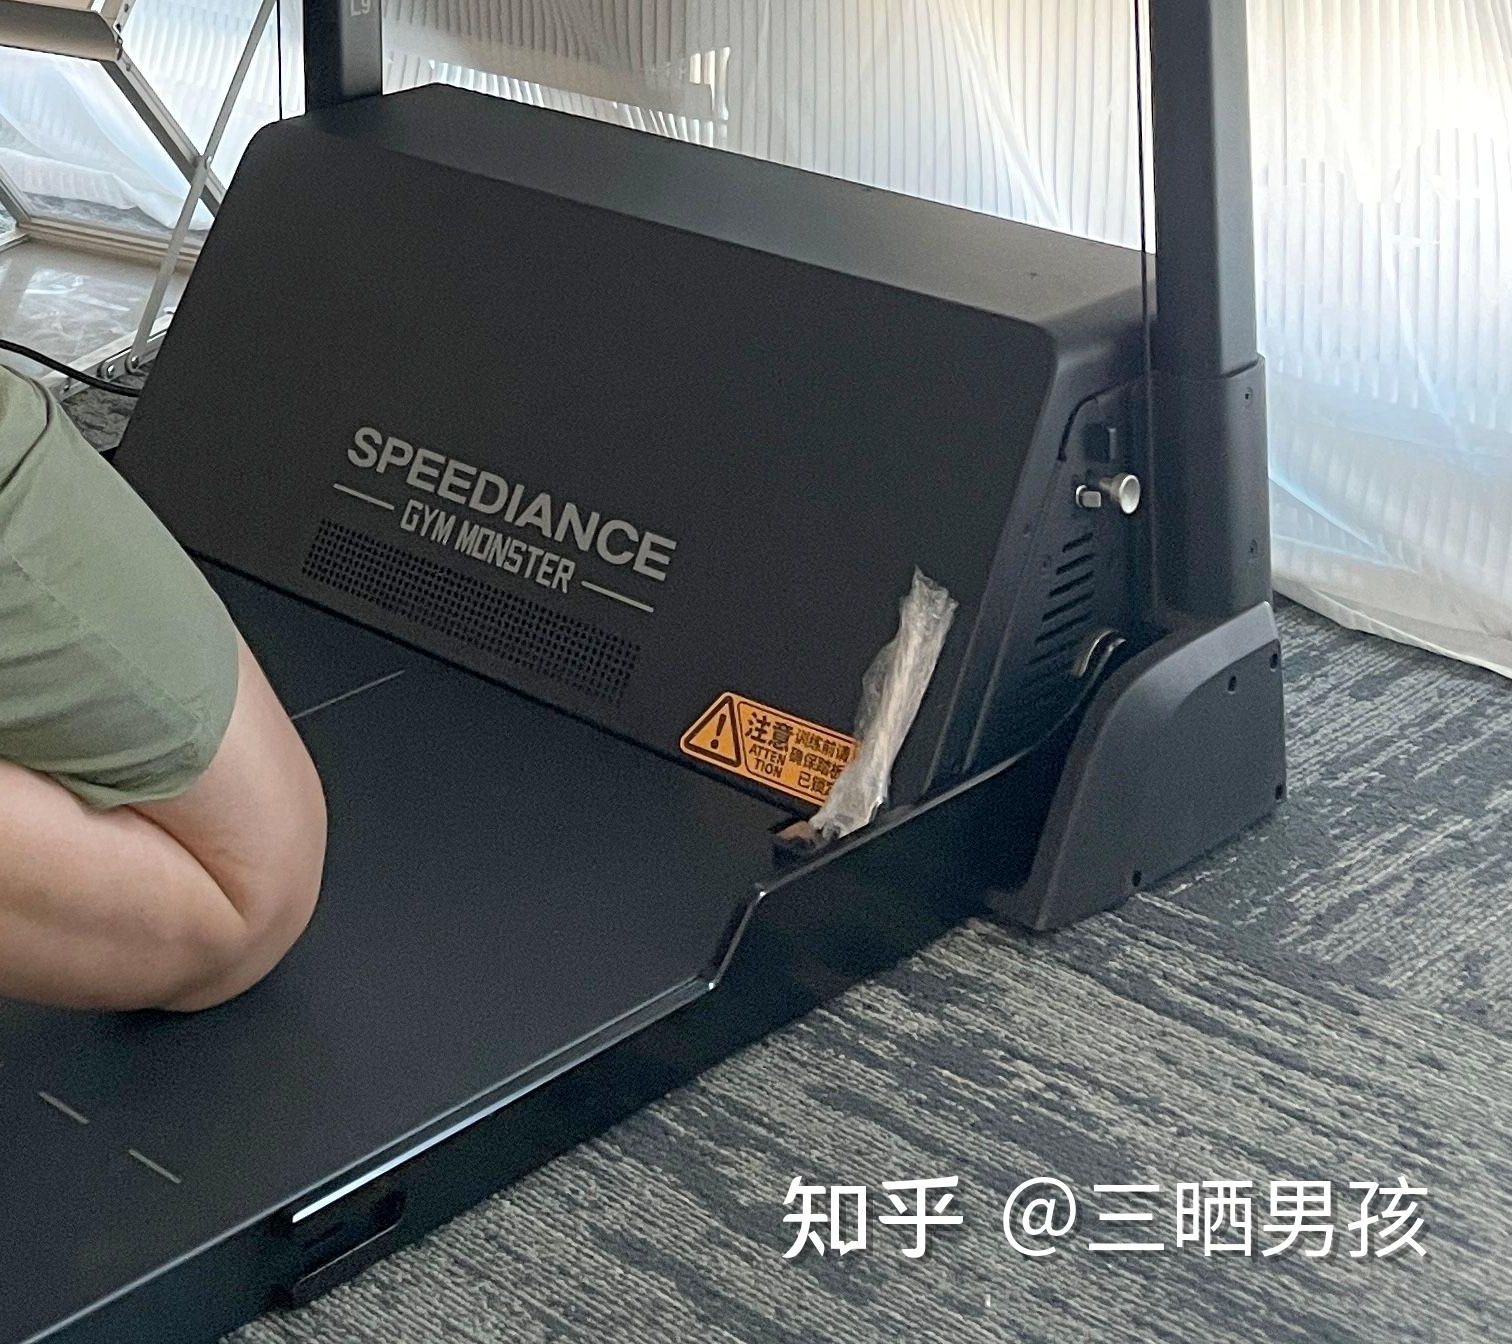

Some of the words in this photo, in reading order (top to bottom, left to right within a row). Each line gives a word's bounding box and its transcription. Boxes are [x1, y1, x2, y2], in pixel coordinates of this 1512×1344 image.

[347, 426, 677, 582] SPEEDIANCE
[400, 499, 456, 545] GYM
[455, 520, 576, 593] MONSTER
[744, 711, 794, 753] 注意
[748, 743, 787, 766] ATTEN
[754, 758, 783, 778] TION
